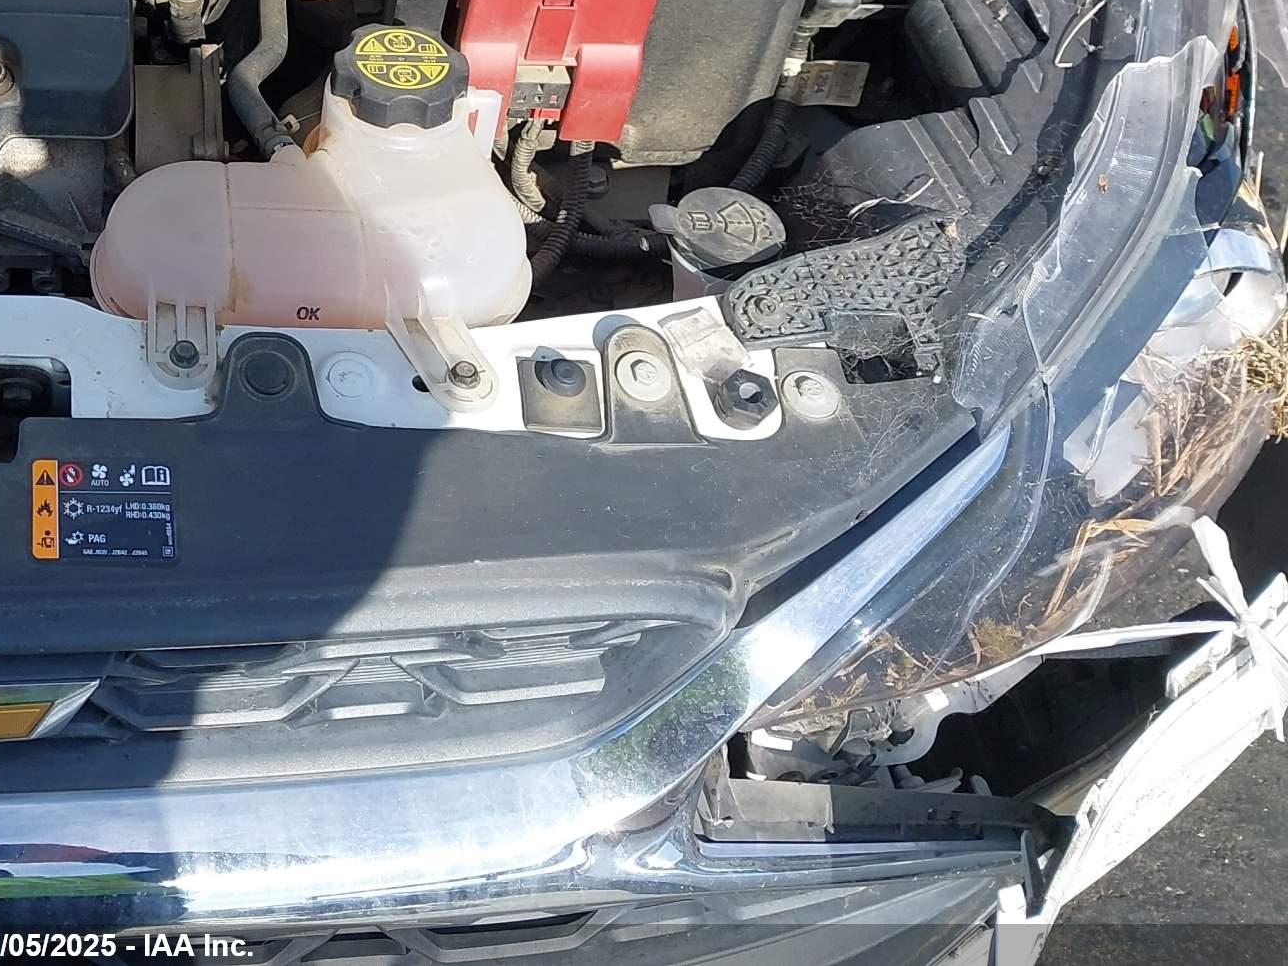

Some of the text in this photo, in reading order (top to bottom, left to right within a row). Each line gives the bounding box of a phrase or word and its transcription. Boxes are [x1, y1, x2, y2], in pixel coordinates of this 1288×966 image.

[296, 306, 321, 321] OK
[90, 479, 110, 487] AUTO
[86, 504, 123, 515] R-1234yf
[88, 533, 106, 544] PAG
